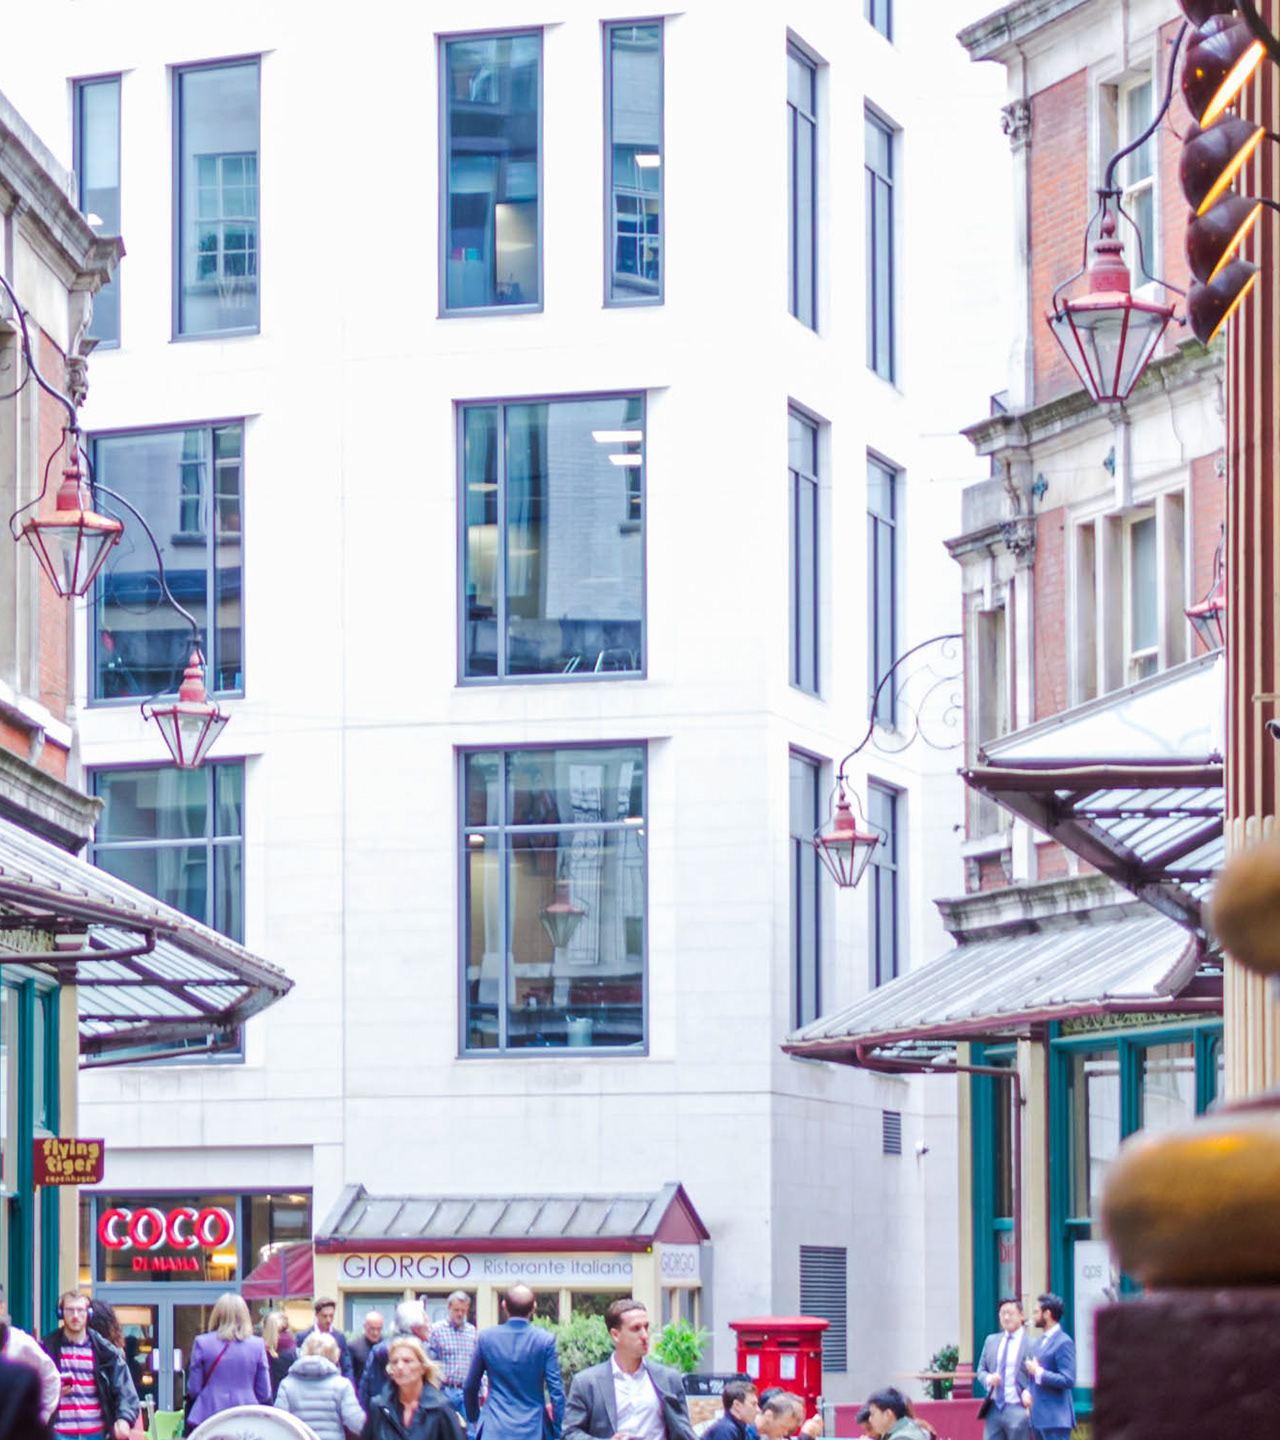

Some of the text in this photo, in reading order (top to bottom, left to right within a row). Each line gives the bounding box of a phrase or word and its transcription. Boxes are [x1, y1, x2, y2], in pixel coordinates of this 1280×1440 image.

[43, 1138, 99, 1160] flying
[45, 1155, 96, 1176] tiger
[97, 1206, 234, 1250] COCO
[132, 1256, 200, 1272] DI MAMA
[343, 1254, 471, 1279] GIORGIO
[483, 1258, 565, 1276] Ristorante
